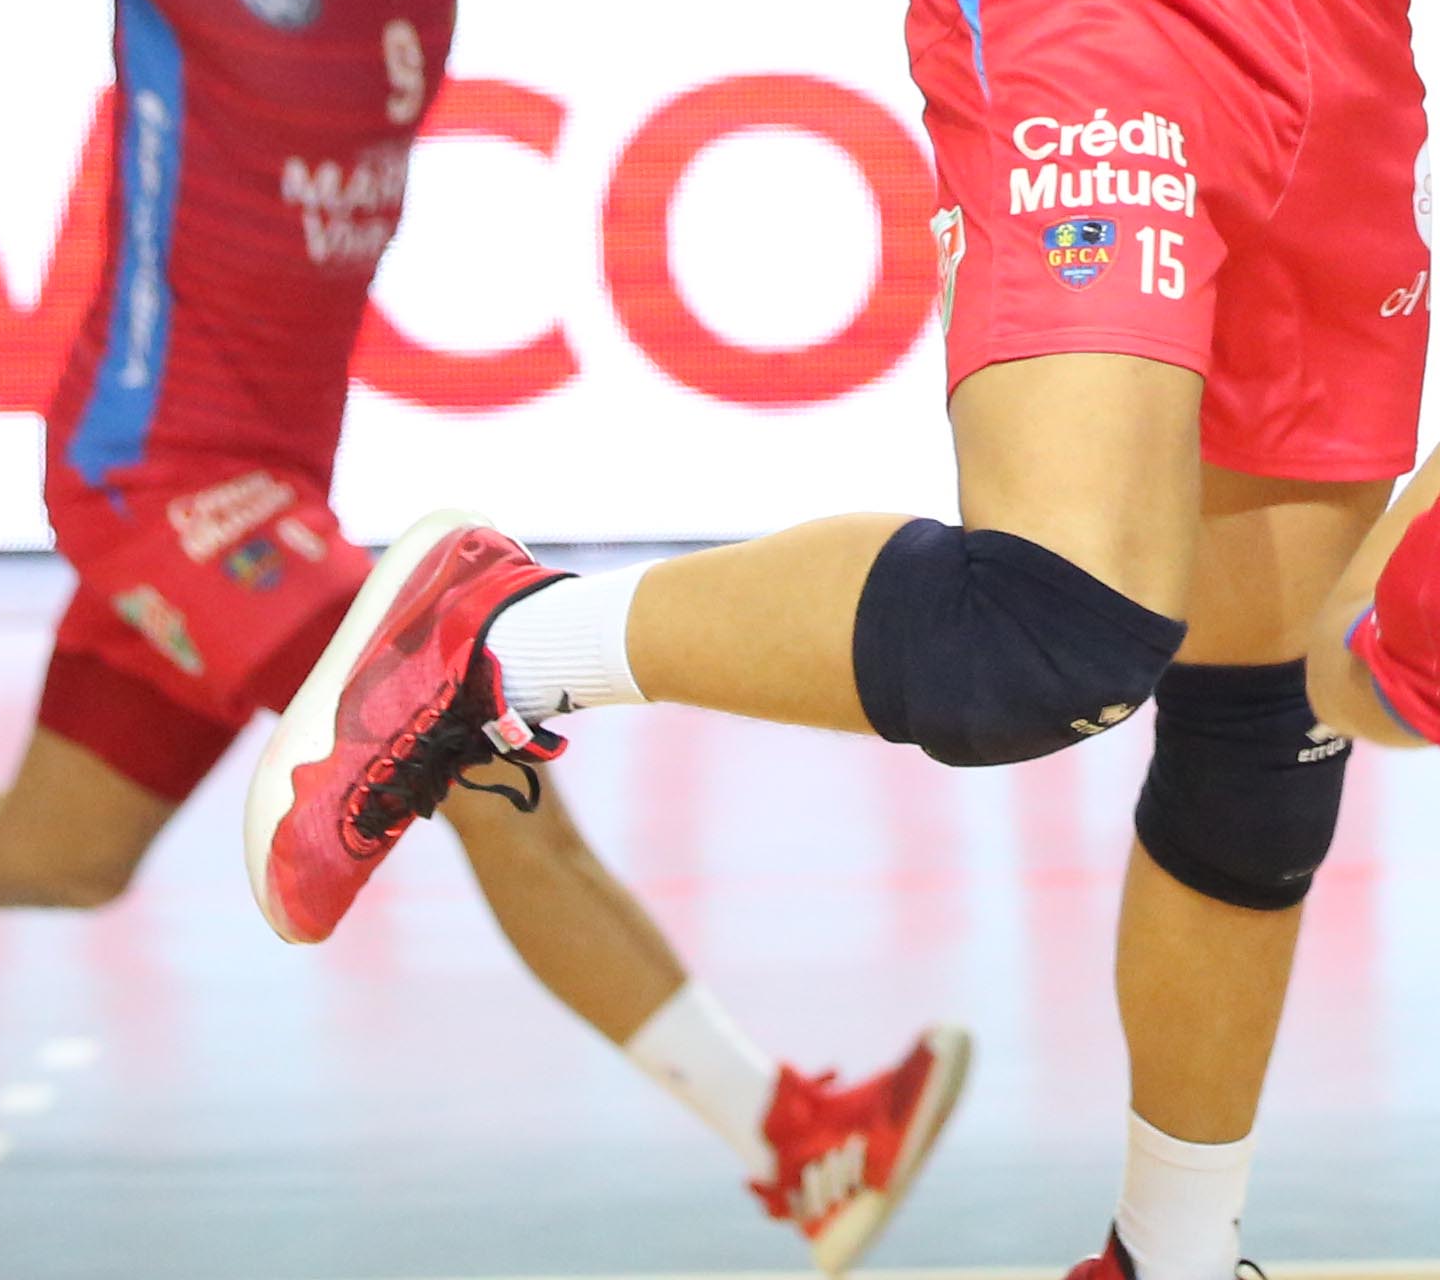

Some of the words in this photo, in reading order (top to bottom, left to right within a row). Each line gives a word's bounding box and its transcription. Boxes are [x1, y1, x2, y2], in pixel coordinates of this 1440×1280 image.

[1012, 108, 1188, 168] Crédit
[1009, 161, 1197, 218] Mutuel
[1048, 247, 1109, 267] GFCA
[1135, 226, 1186, 301] 15
